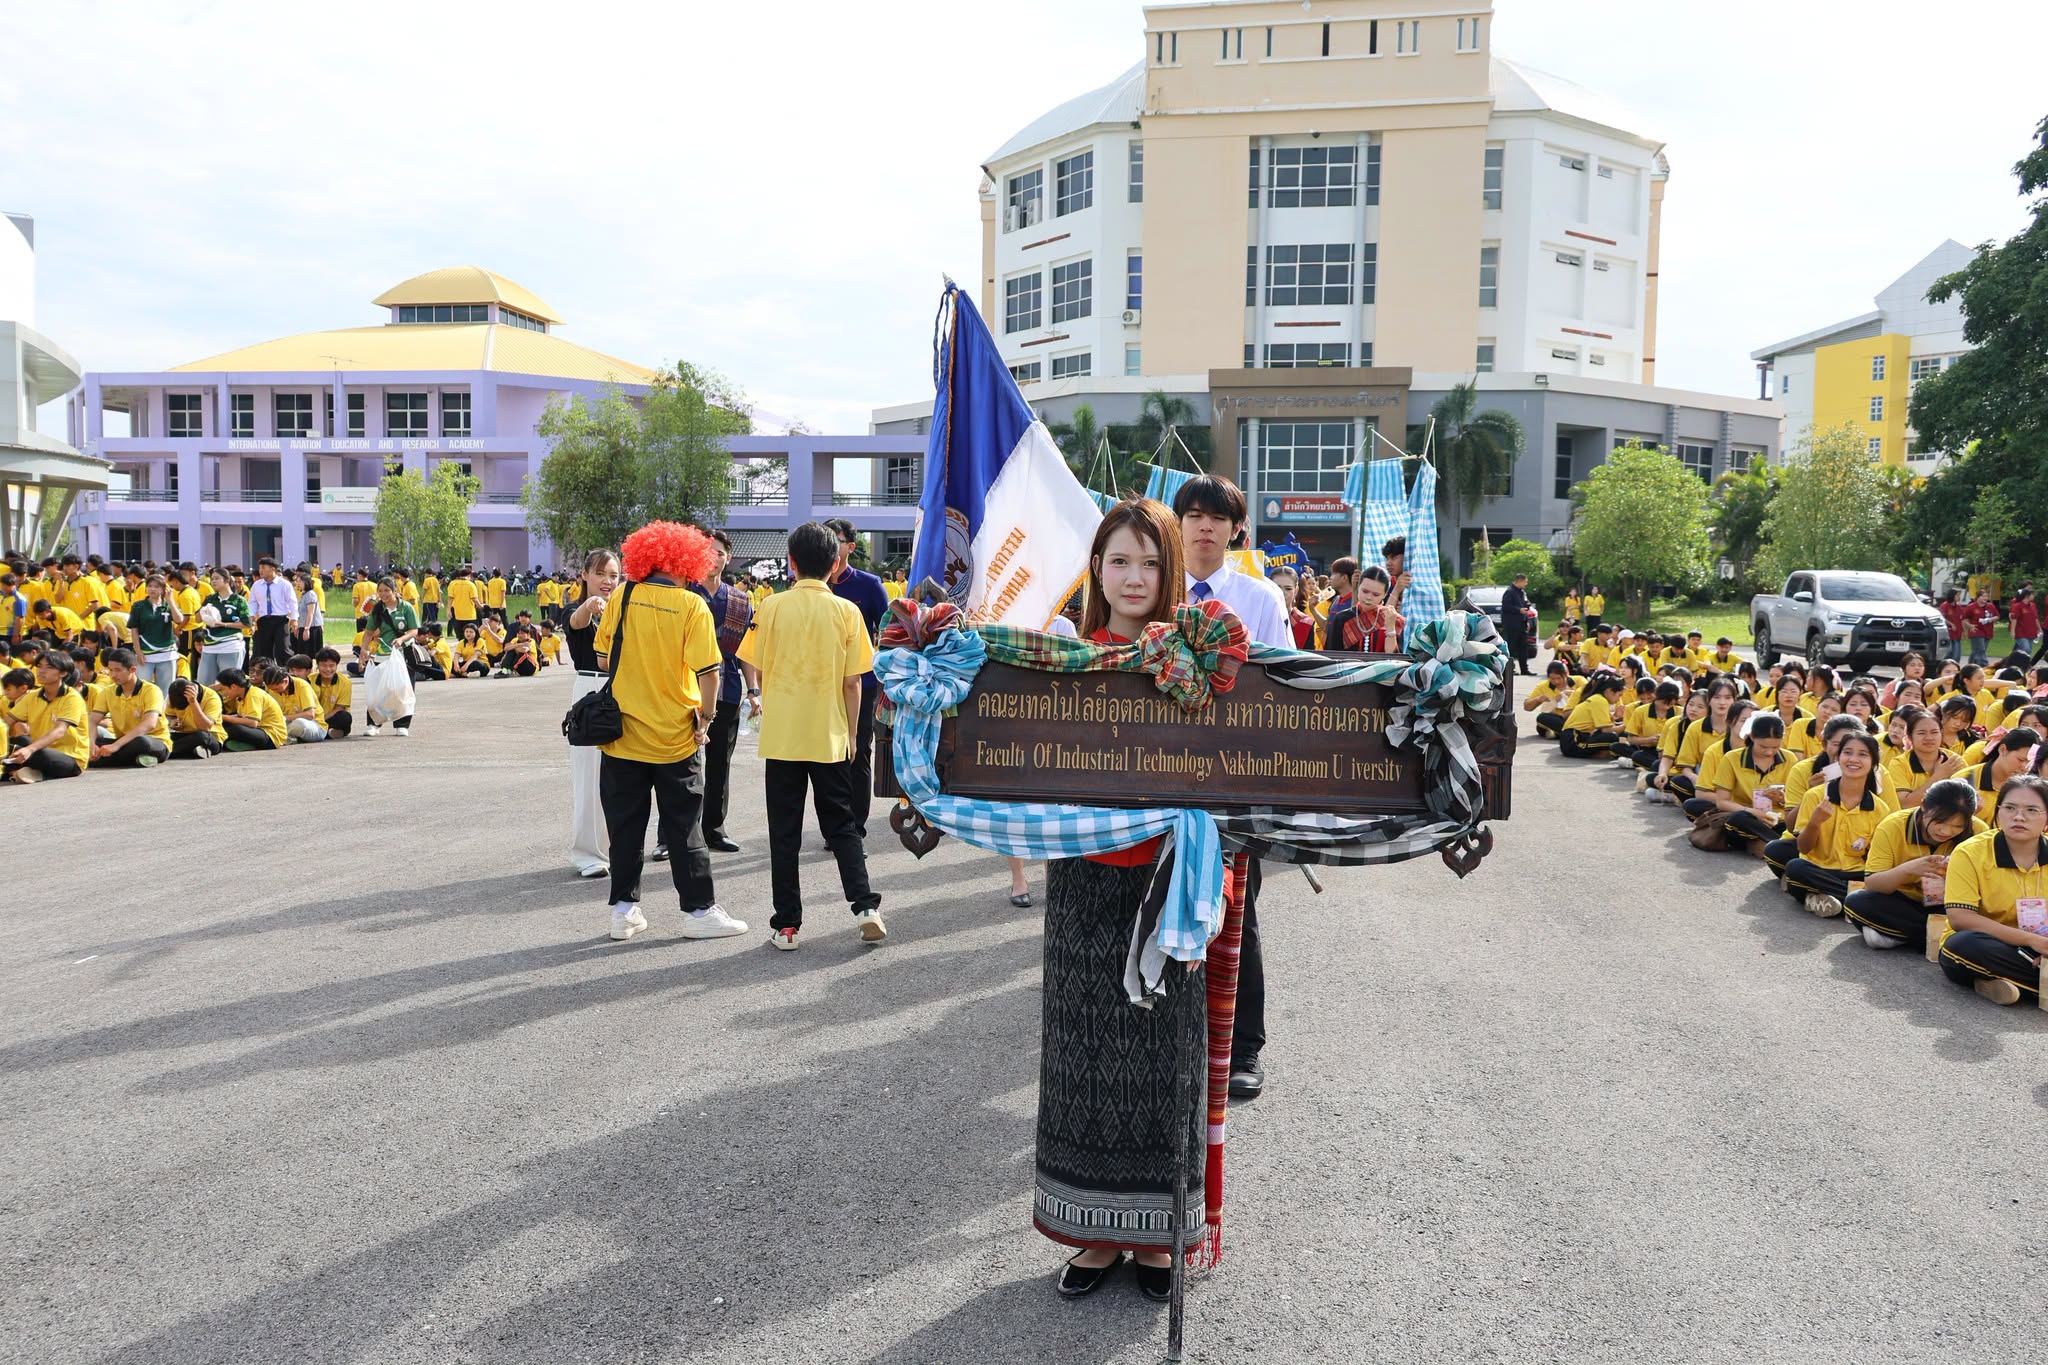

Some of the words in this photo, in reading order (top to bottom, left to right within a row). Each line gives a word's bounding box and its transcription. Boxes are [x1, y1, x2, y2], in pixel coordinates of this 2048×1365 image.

[228, 439, 281, 450] INTERNATIONAL
[290, 439, 322, 450] AVIATION
[331, 439, 370, 450] EDUCATION
[378, 439, 394, 450] AND
[402, 439, 440, 450] RESEARCH
[448, 439, 485, 450] ACADEMY
[1284, 500, 1344, 511] สำนักวิทยบริการ
[1225, 690, 1386, 734] มหาวิทยาลัยนครพ
[1033, 741, 1053, 769] Of
[1055, 743, 1129, 772] Industrial
[1134, 746, 1214, 782] Technology
